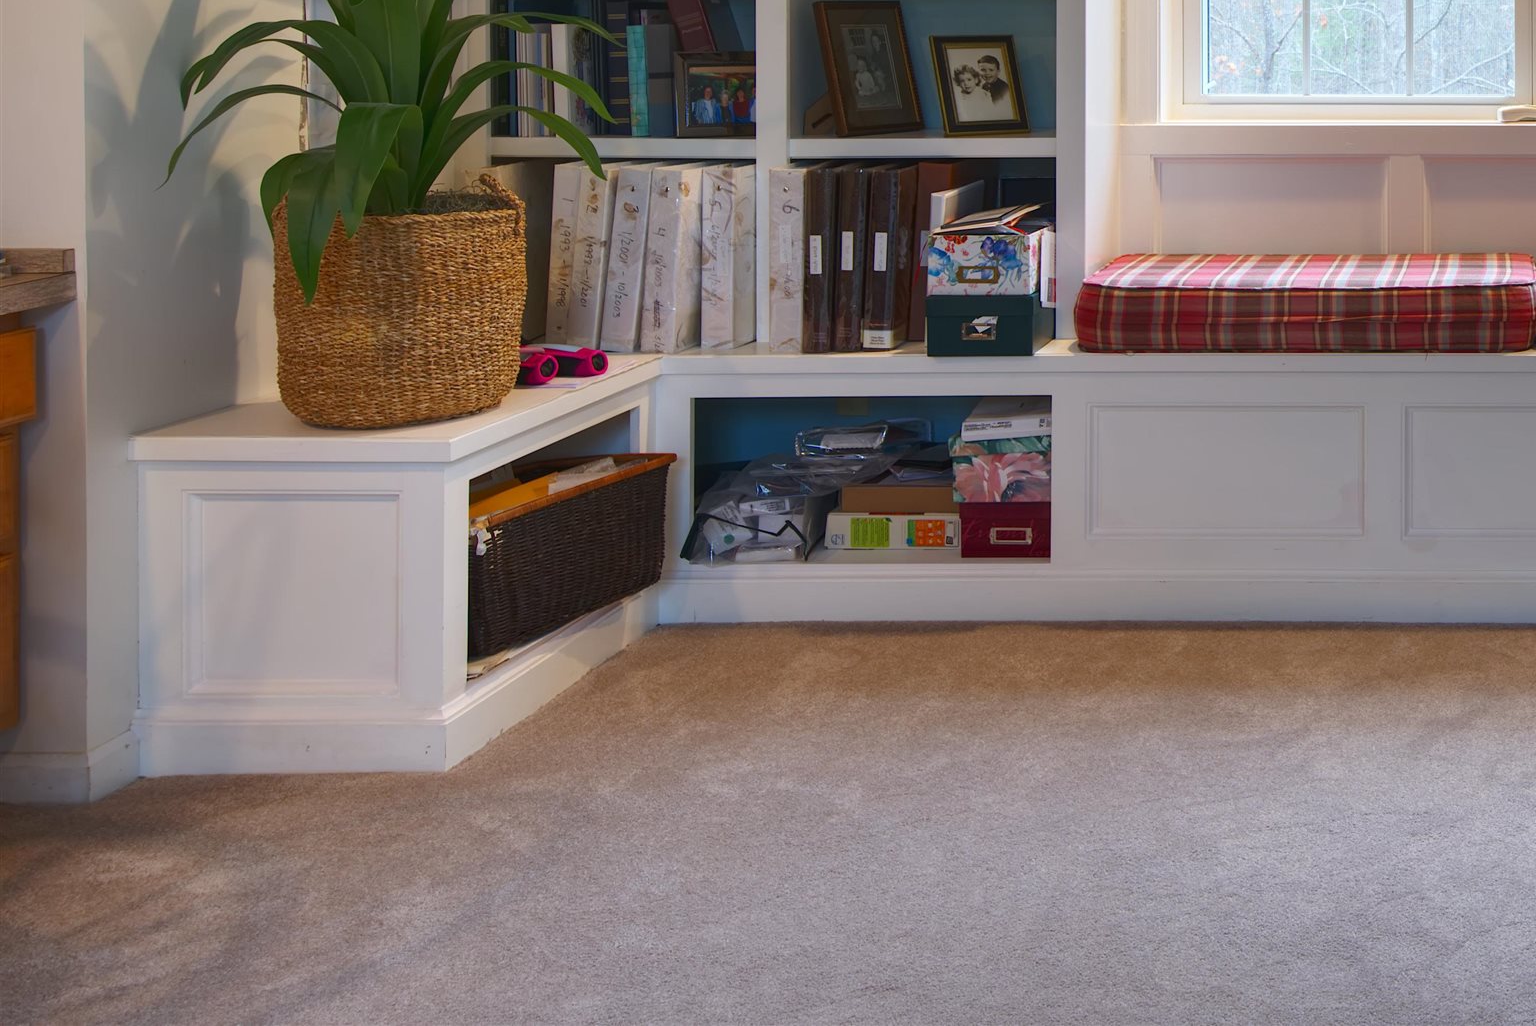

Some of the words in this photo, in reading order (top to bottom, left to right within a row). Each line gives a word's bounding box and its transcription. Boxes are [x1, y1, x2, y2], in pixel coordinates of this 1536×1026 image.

[623, 202, 640, 213] 3
[782, 203, 799, 214] 6
[559, 225, 571, 253] 1993
[653, 227, 666, 237] 4
[618, 231, 634, 264] 1/2001
[612, 281, 629, 319] 10/2003
